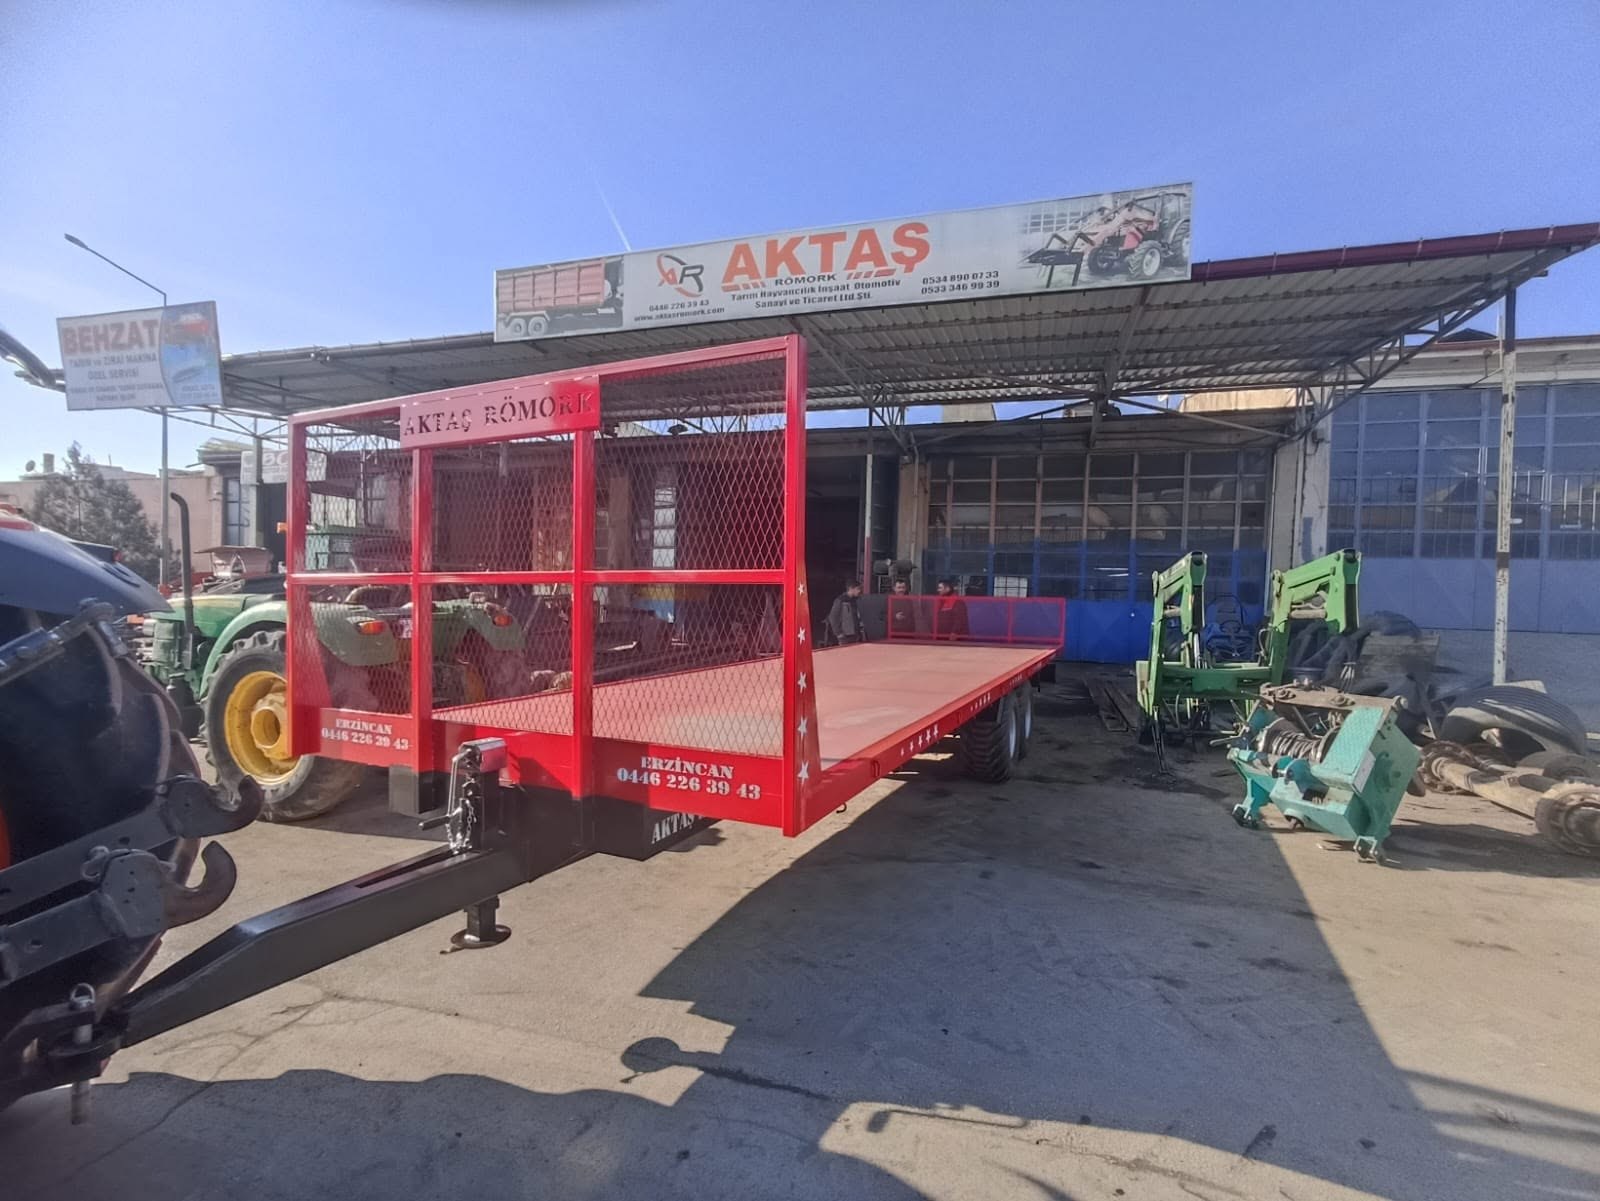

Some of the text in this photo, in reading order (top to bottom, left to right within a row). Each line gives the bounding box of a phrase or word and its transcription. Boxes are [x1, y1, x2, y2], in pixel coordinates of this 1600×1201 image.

[721, 222, 931, 283] AKTAŞ
[775, 274, 838, 287] RÖMORK
[921, 280, 1000, 294] 0533 346 99 39
[922, 270, 999, 285] 0534 890 07 33
[732, 291, 759, 301] Tarım
[760, 285, 816, 299] Hayvancılık
[854, 279, 902, 291] Otomotiv
[755, 298, 788, 309] Sanayi
[789, 297, 800, 305] ve
[803, 293, 838, 304] Ticaret
[61, 319, 160, 355] BEHZAT
[404, 391, 594, 436] AKTAŞ RÖMORK
[335, 717, 393, 735] ERZİNCAN
[321, 727, 409, 751] 0446 226 39 43
[641, 756, 734, 780] ERZİNCAN
[617, 767, 761, 800] 0446 226 39 43
[651, 813, 696, 844] AKTAŞ
